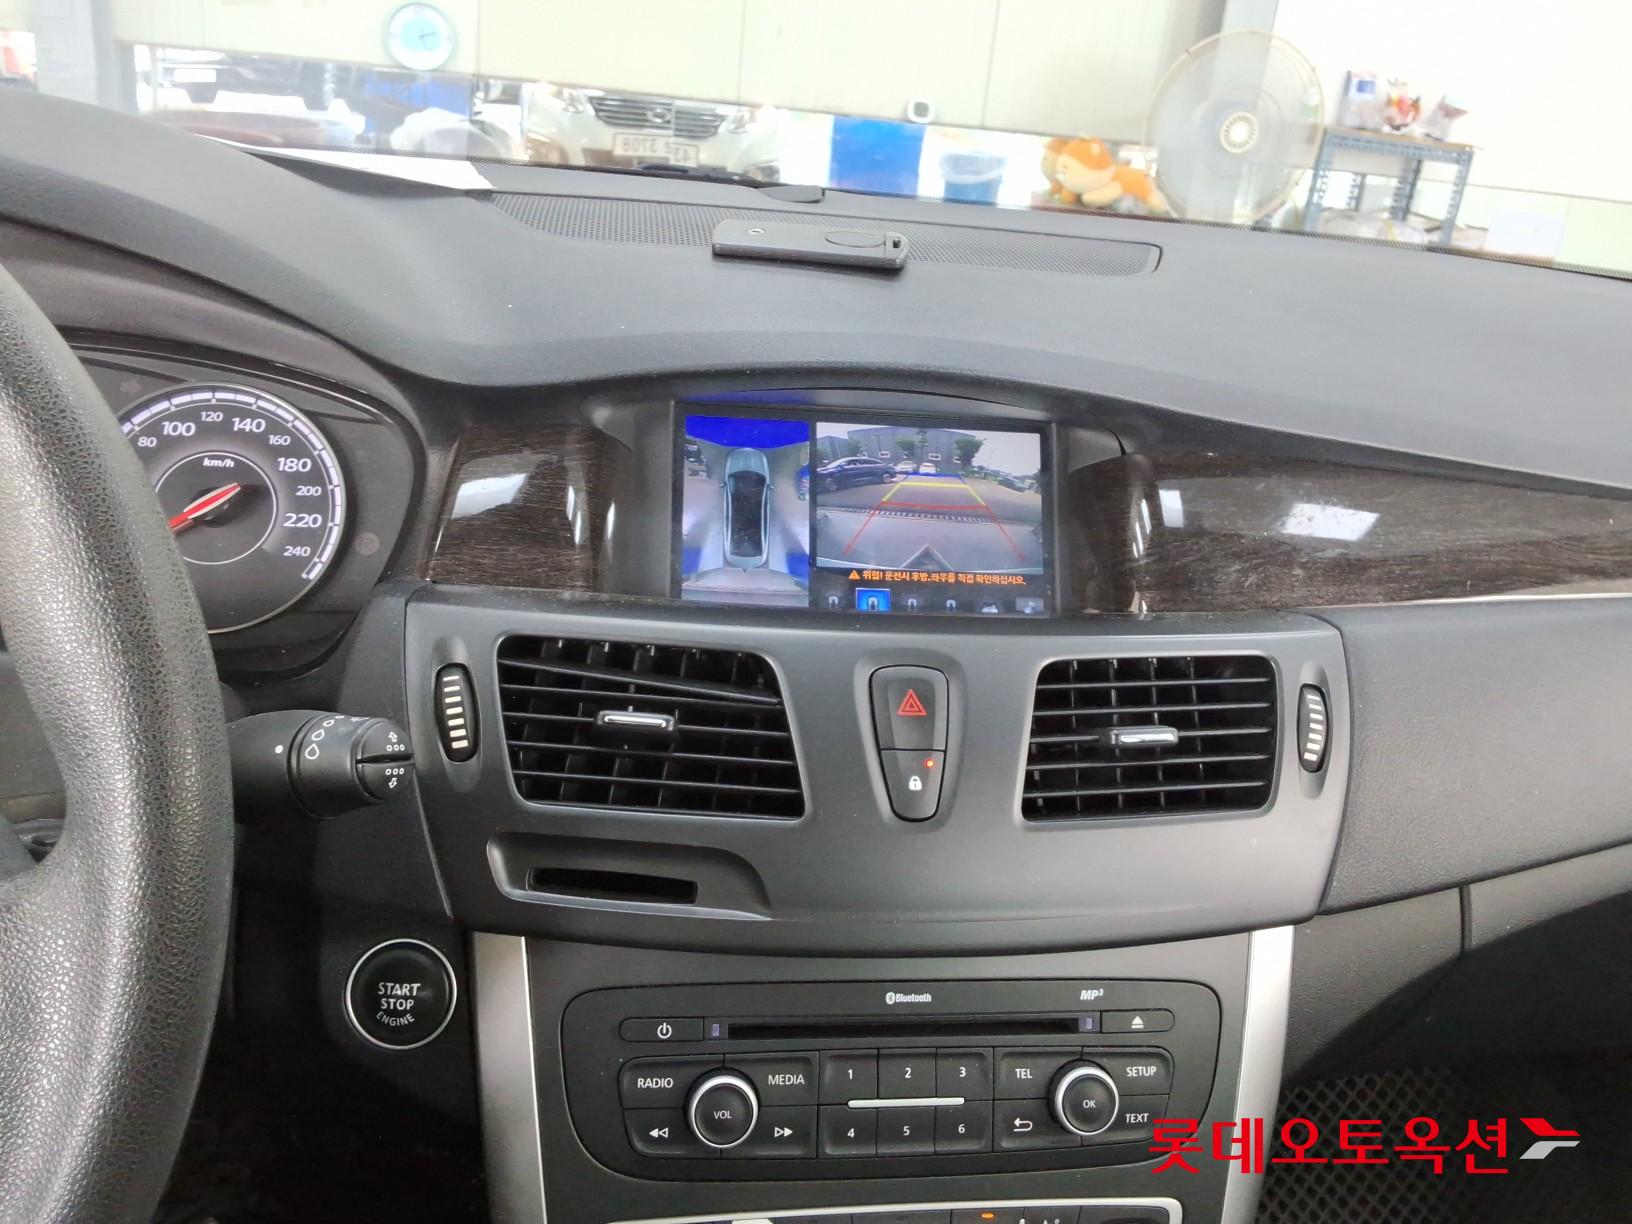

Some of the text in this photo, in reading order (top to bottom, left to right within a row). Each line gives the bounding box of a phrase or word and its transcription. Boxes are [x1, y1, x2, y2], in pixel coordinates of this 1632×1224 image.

[201, 411, 223, 422] 120
[161, 421, 196, 436] 100
[232, 417, 266, 432] 140
[137, 436, 157, 447] 80
[268, 435, 291, 445] 160
[203, 457, 235, 468] km/h
[278, 457, 312, 472] 180
[296, 486, 321, 496] 200
[283, 513, 321, 528] 220
[283, 546, 311, 557] 240
[378, 982, 421, 996] START
[895, 992, 932, 1003] Bluetooth
[380, 998, 414, 1010] STOP
[376, 1011, 415, 1026] ENGINE
[847, 1069, 854, 1080] 1
[904, 1067, 912, 1079] 2
[959, 1066, 966, 1078] 3
[1015, 1068, 1033, 1079] TEL
[1126, 1066, 1157, 1077] SETUP
[637, 1077, 674, 1089] RADIO
[768, 1074, 805, 1086] MEDIA
[1083, 1098, 1097, 1109] OK
[713, 1109, 733, 1120] VOL
[1125, 1113, 1149, 1123] TEXT
[847, 1127, 855, 1138] 4
[903, 1125, 910, 1136] 5
[958, 1123, 966, 1134] 6
